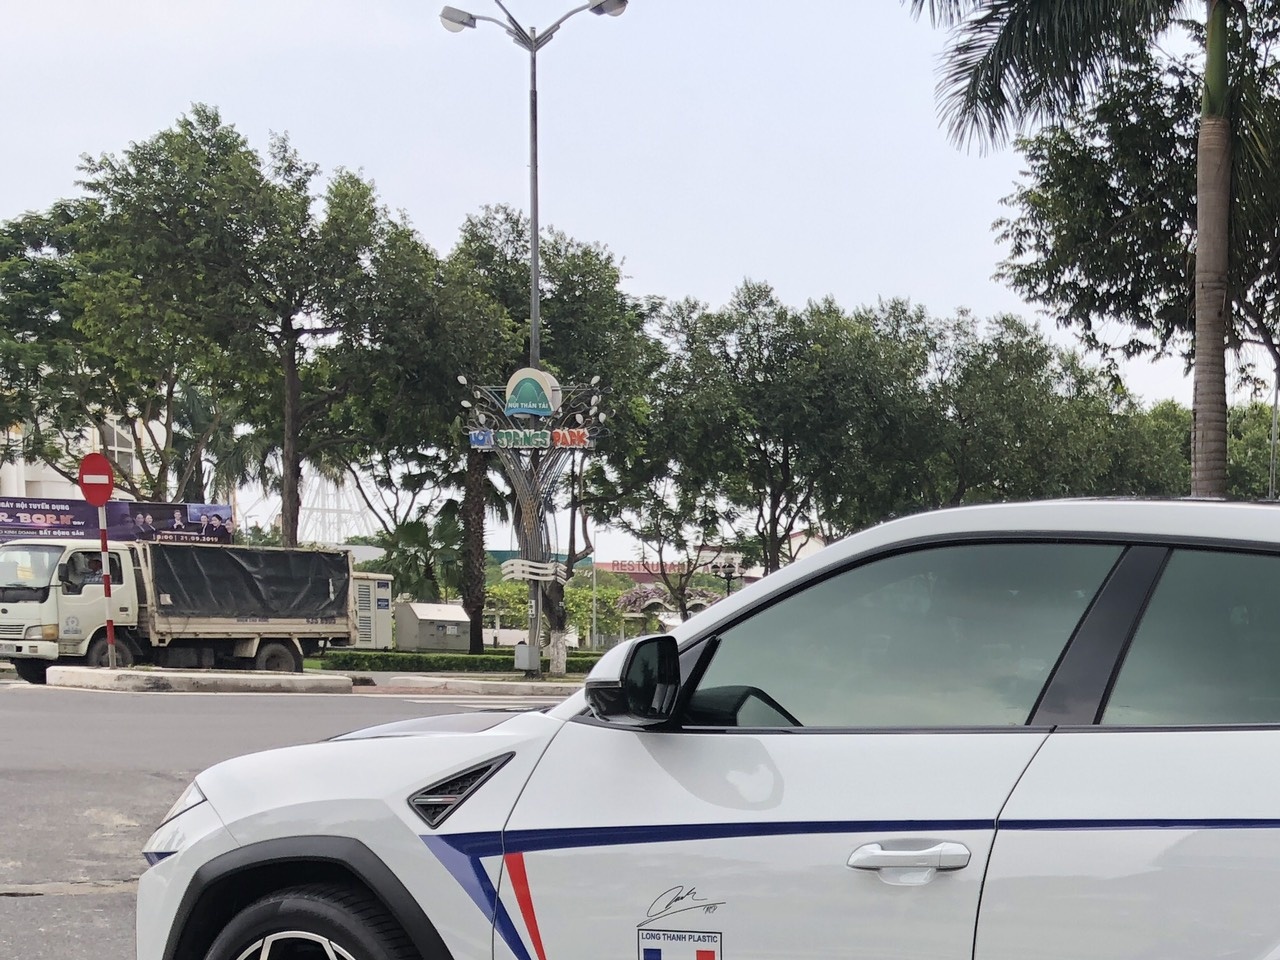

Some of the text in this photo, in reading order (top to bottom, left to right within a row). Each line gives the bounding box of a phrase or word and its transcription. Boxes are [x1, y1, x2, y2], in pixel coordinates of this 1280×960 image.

[552, 428, 589, 449] PARK
[16, 513, 75, 525] BORN
[641, 932, 718, 943] LONG THANH PLASTIC
